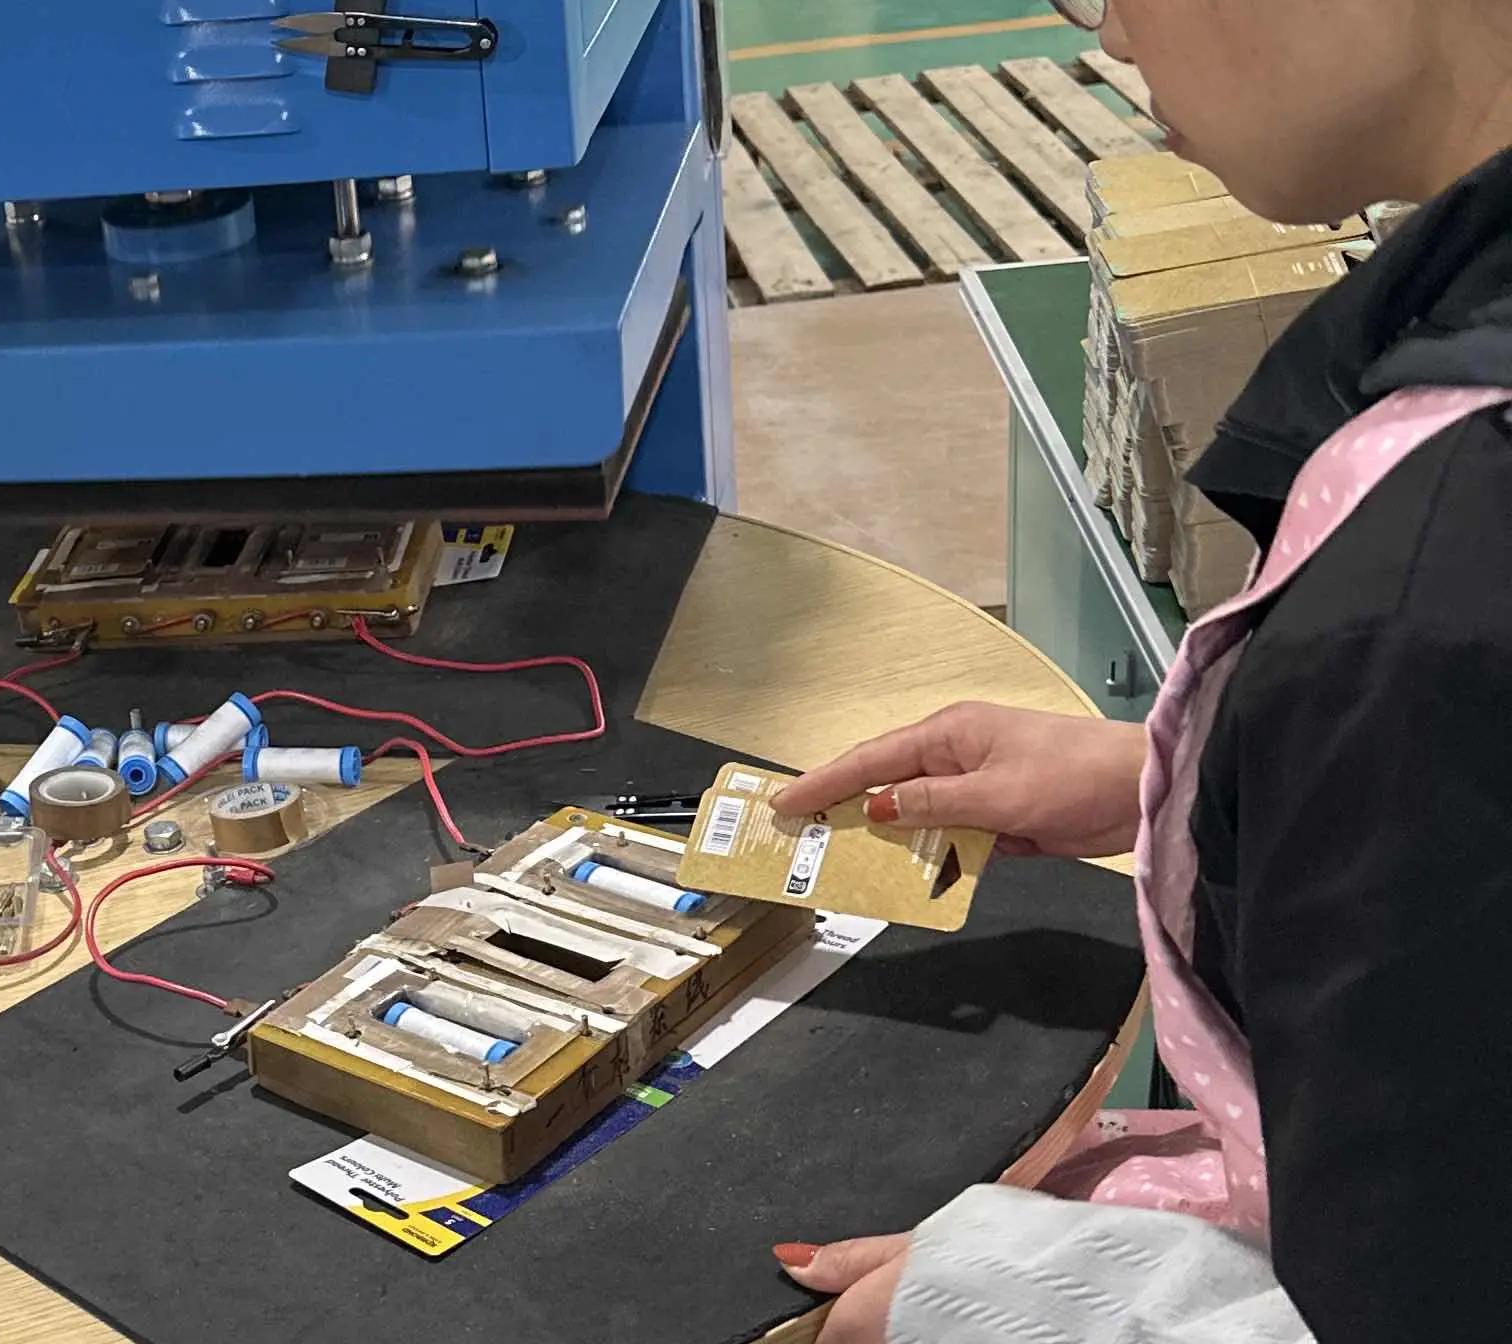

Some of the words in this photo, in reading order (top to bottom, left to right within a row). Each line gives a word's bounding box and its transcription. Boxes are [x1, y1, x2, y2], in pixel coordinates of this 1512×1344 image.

[237, 783, 265, 798] PACK
[240, 797, 268, 811] PACK
[324, 1158, 361, 1180] Thread
[339, 1154, 377, 1178] Colours
[360, 1176, 406, 1203] Polyester
[375, 1172, 403, 1189] Multi
